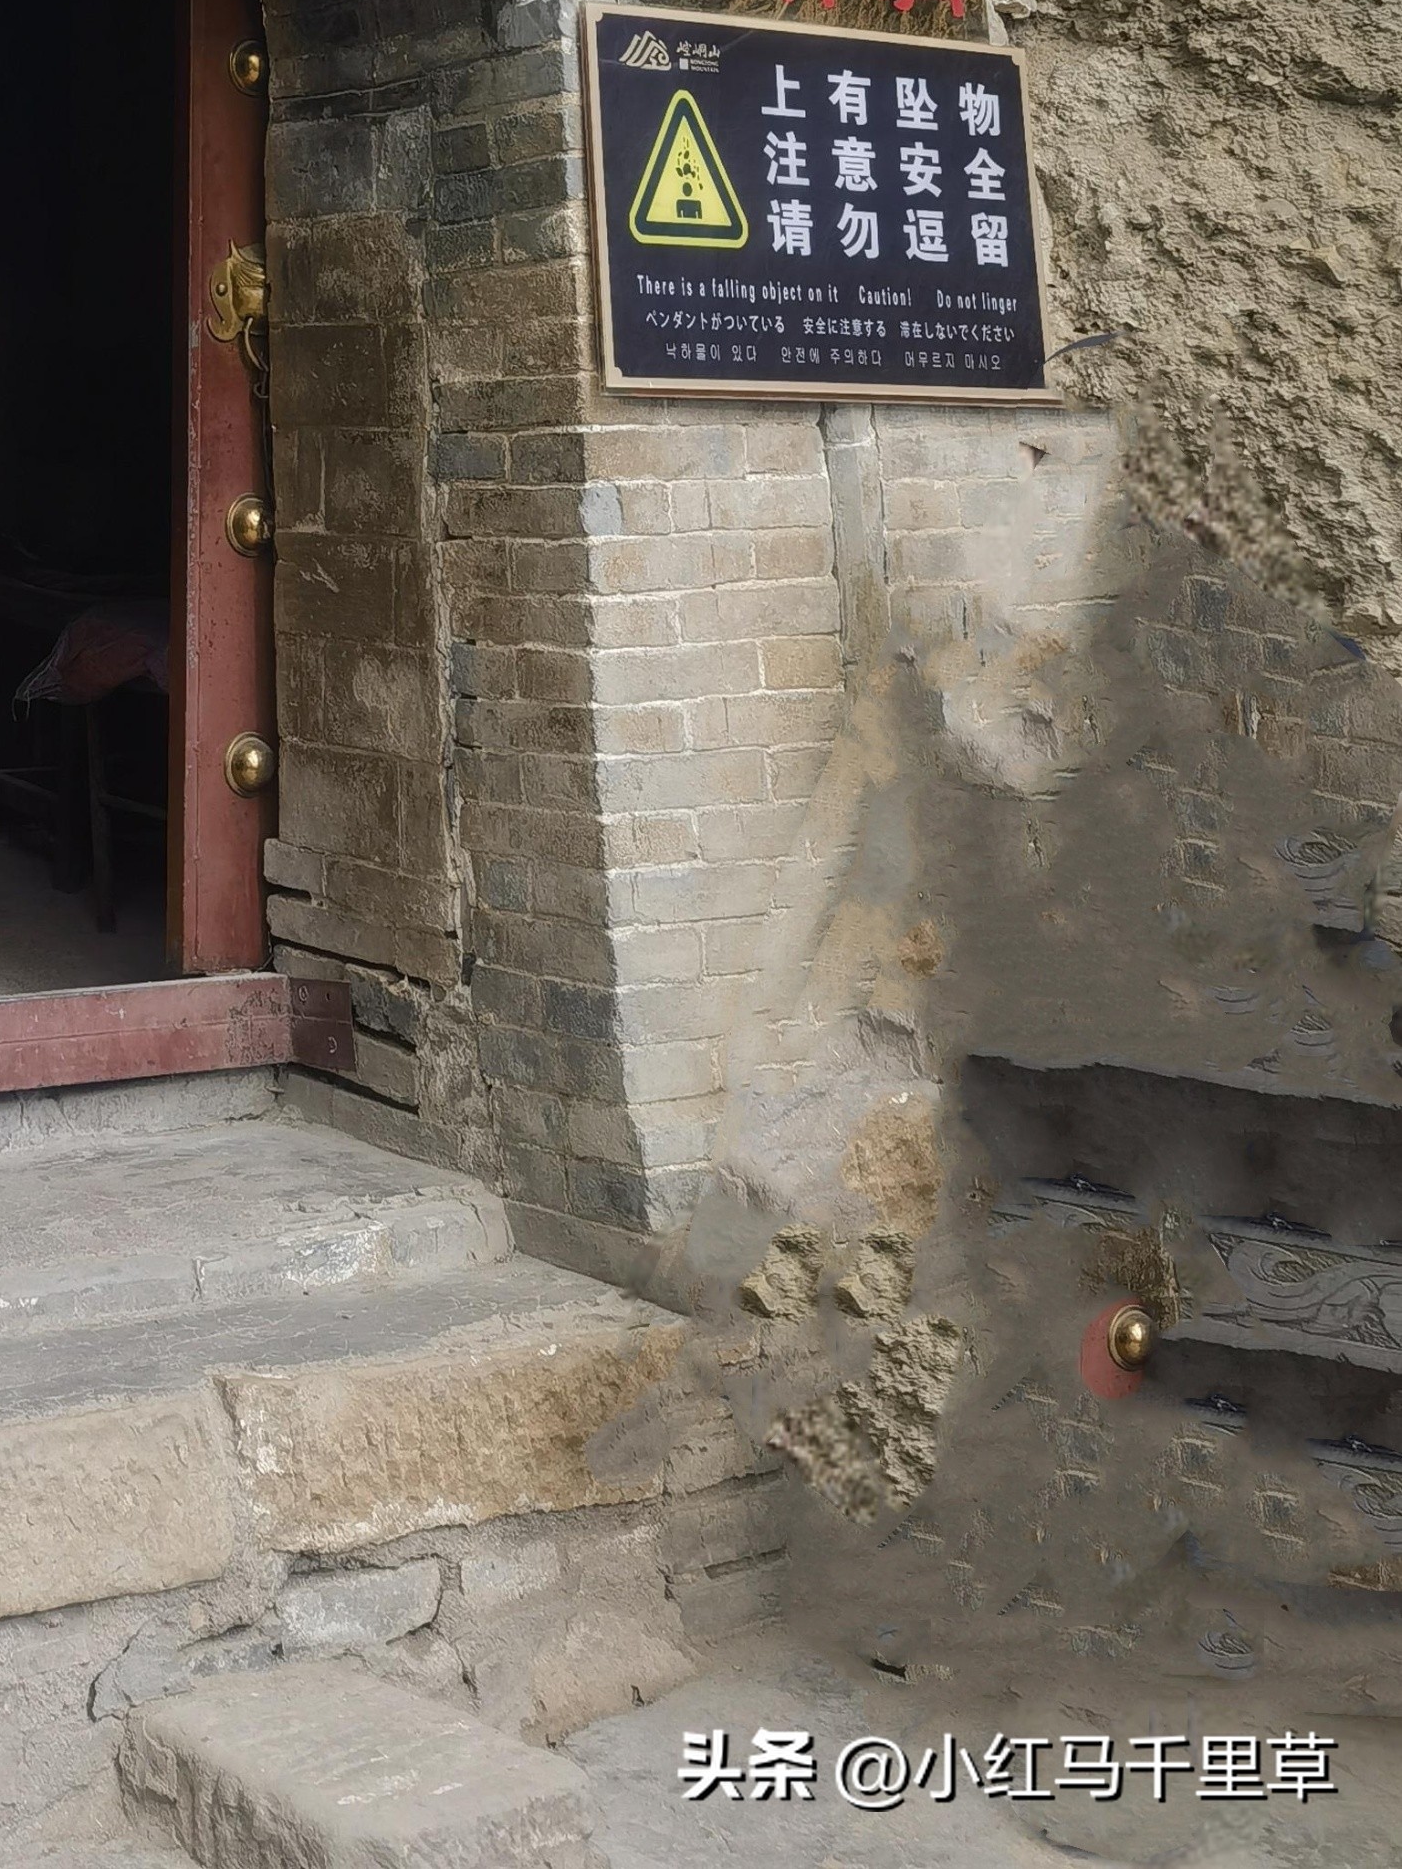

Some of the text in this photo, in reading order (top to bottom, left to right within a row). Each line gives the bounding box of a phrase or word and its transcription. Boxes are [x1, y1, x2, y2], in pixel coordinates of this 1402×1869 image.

[761, 64, 1001, 137] 上有坠物
[763, 132, 1006, 202] 注意安全
[766, 199, 1010, 268] 请勿逗留
[636, 274, 1018, 316] There is a falling object on it Caution! Do not linger
[645, 309, 785, 334] ペンダントがついている
[802, 315, 887, 338] 安全に注意する
[731, 343, 757, 363] 있다
[780, 345, 821, 365] 안전에
[830, 347, 883, 367] 주의하다
[964, 353, 1002, 371] 마시오
